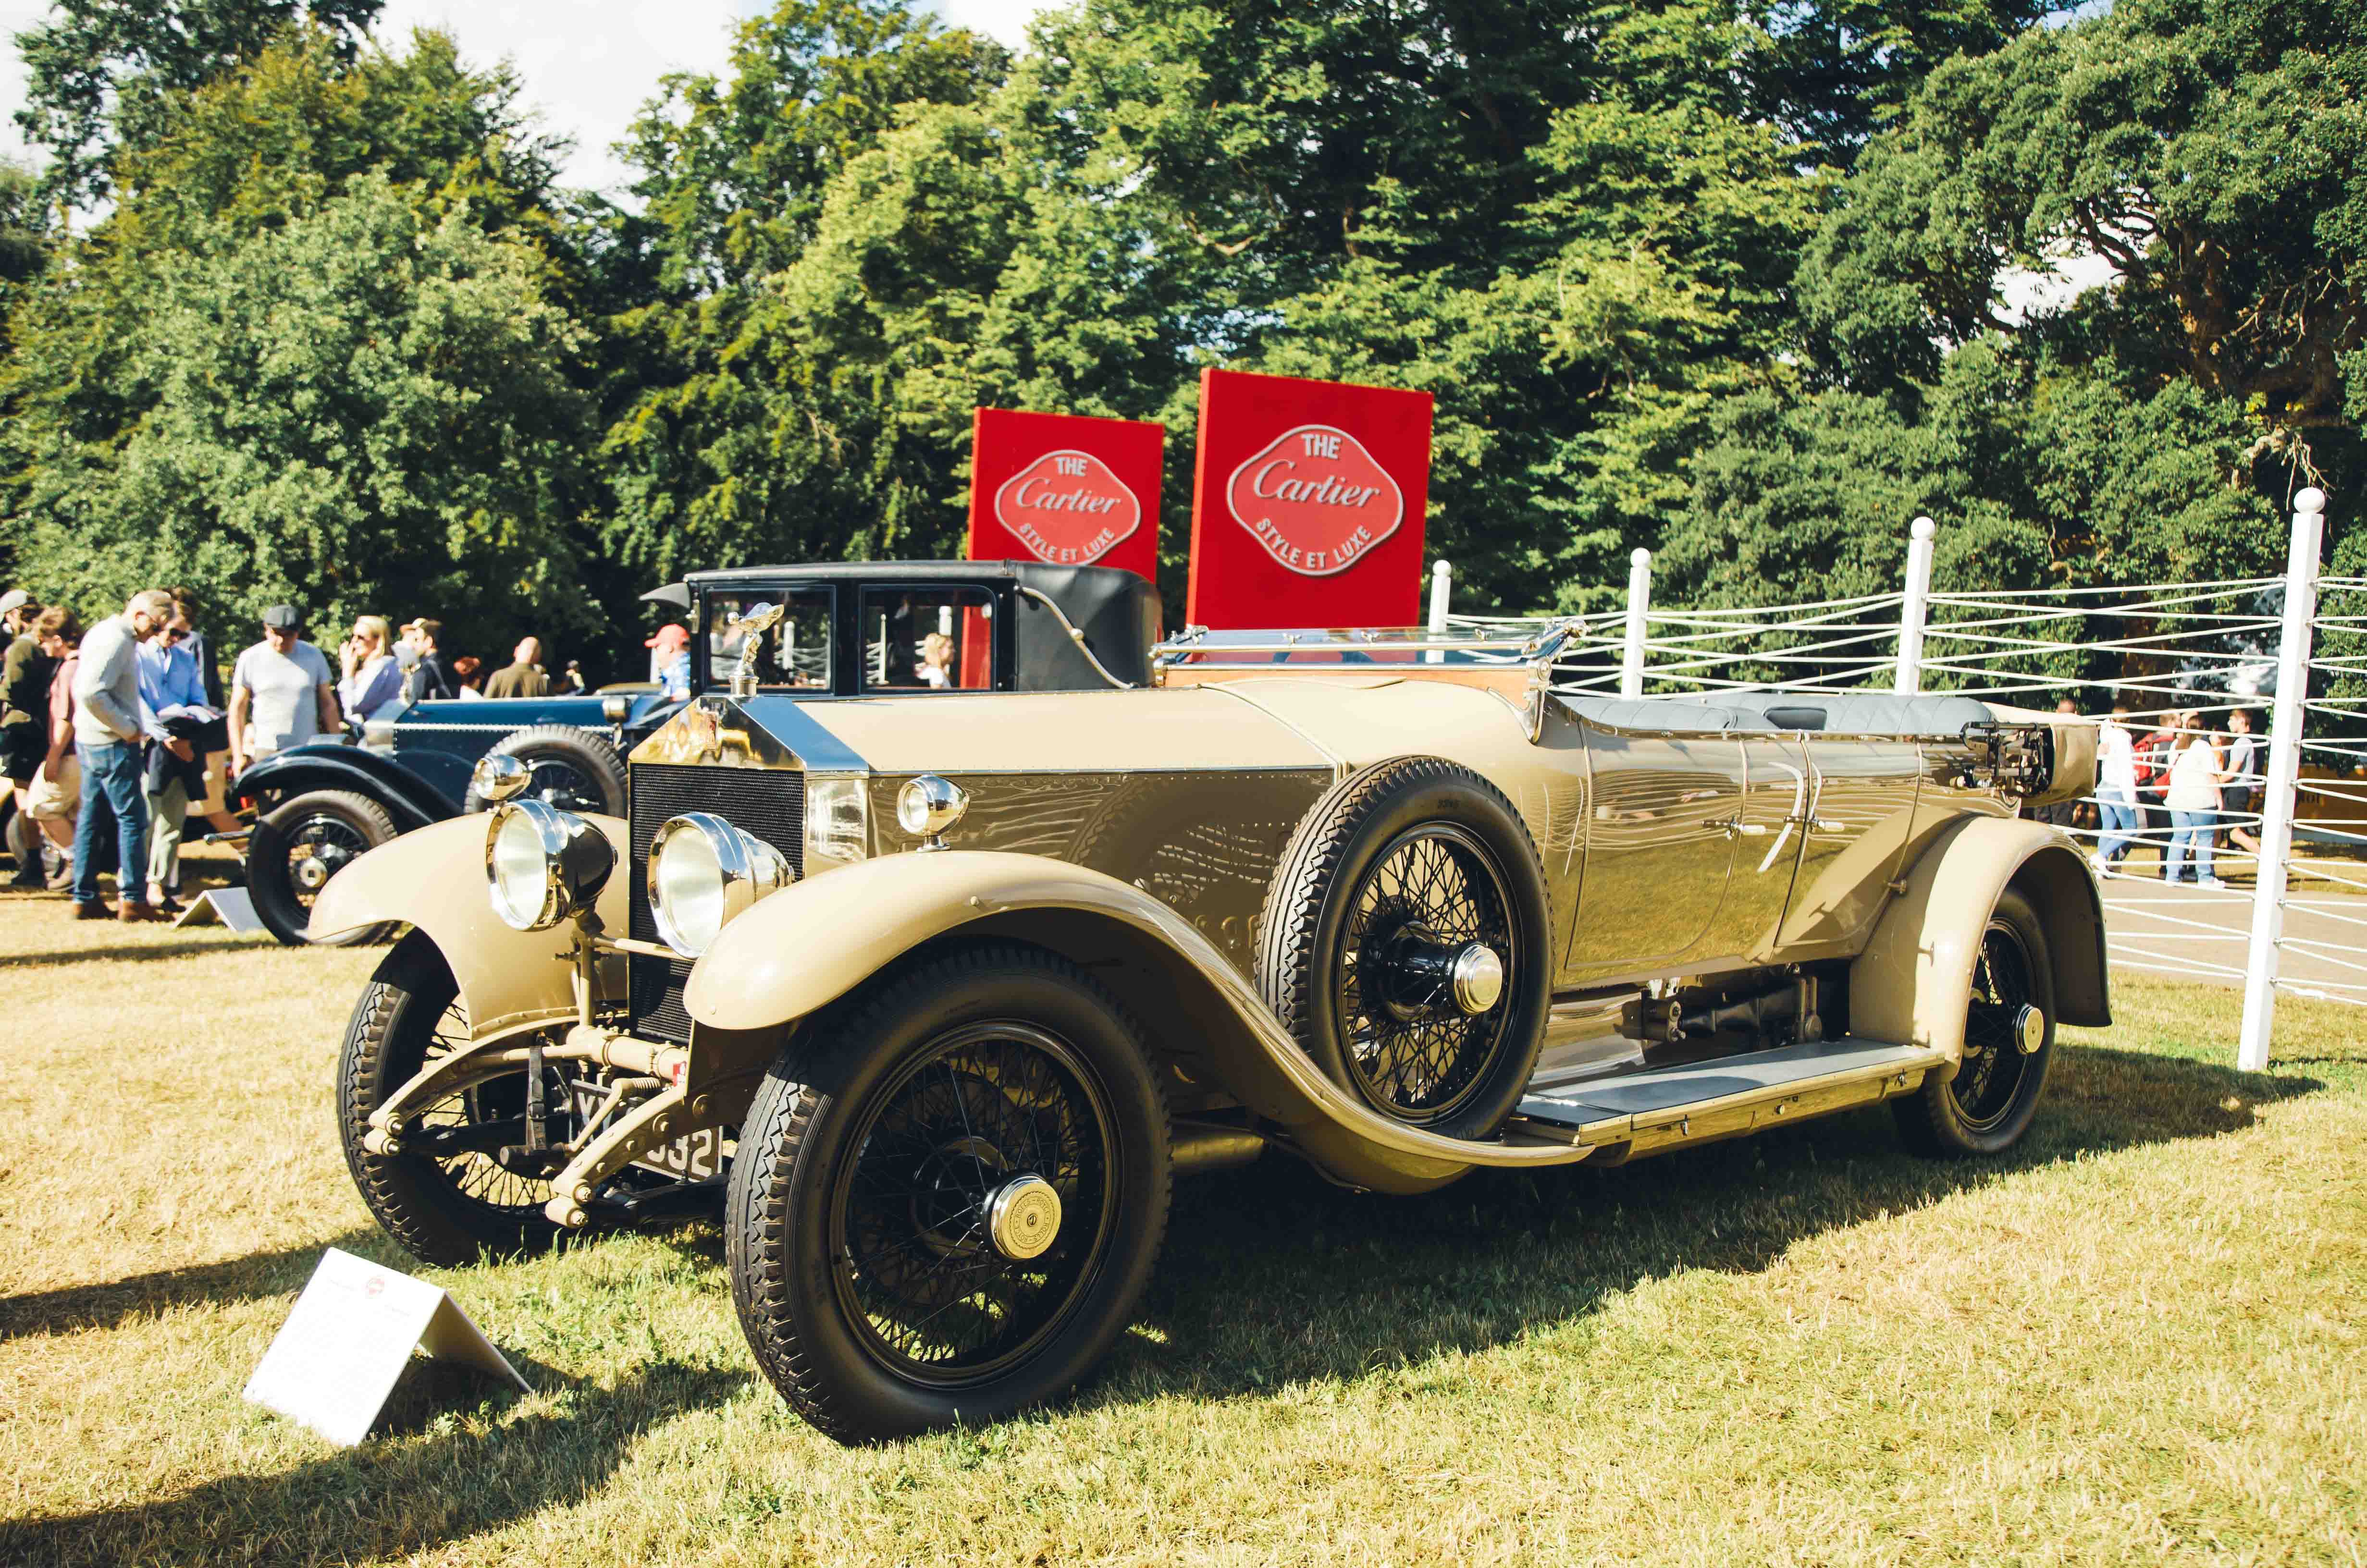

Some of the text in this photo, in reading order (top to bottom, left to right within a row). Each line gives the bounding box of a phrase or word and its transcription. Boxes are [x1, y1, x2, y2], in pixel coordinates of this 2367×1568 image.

[1301, 433, 1341, 459] THE
[1056, 457, 1087, 476] THE
[1254, 459, 1381, 507] Cartier
[1016, 477, 1121, 513] Cartier
[1019, 523, 1115, 562] STYLE ET LUXE
[1256, 518, 1371, 568] STYLE ET LUXE
